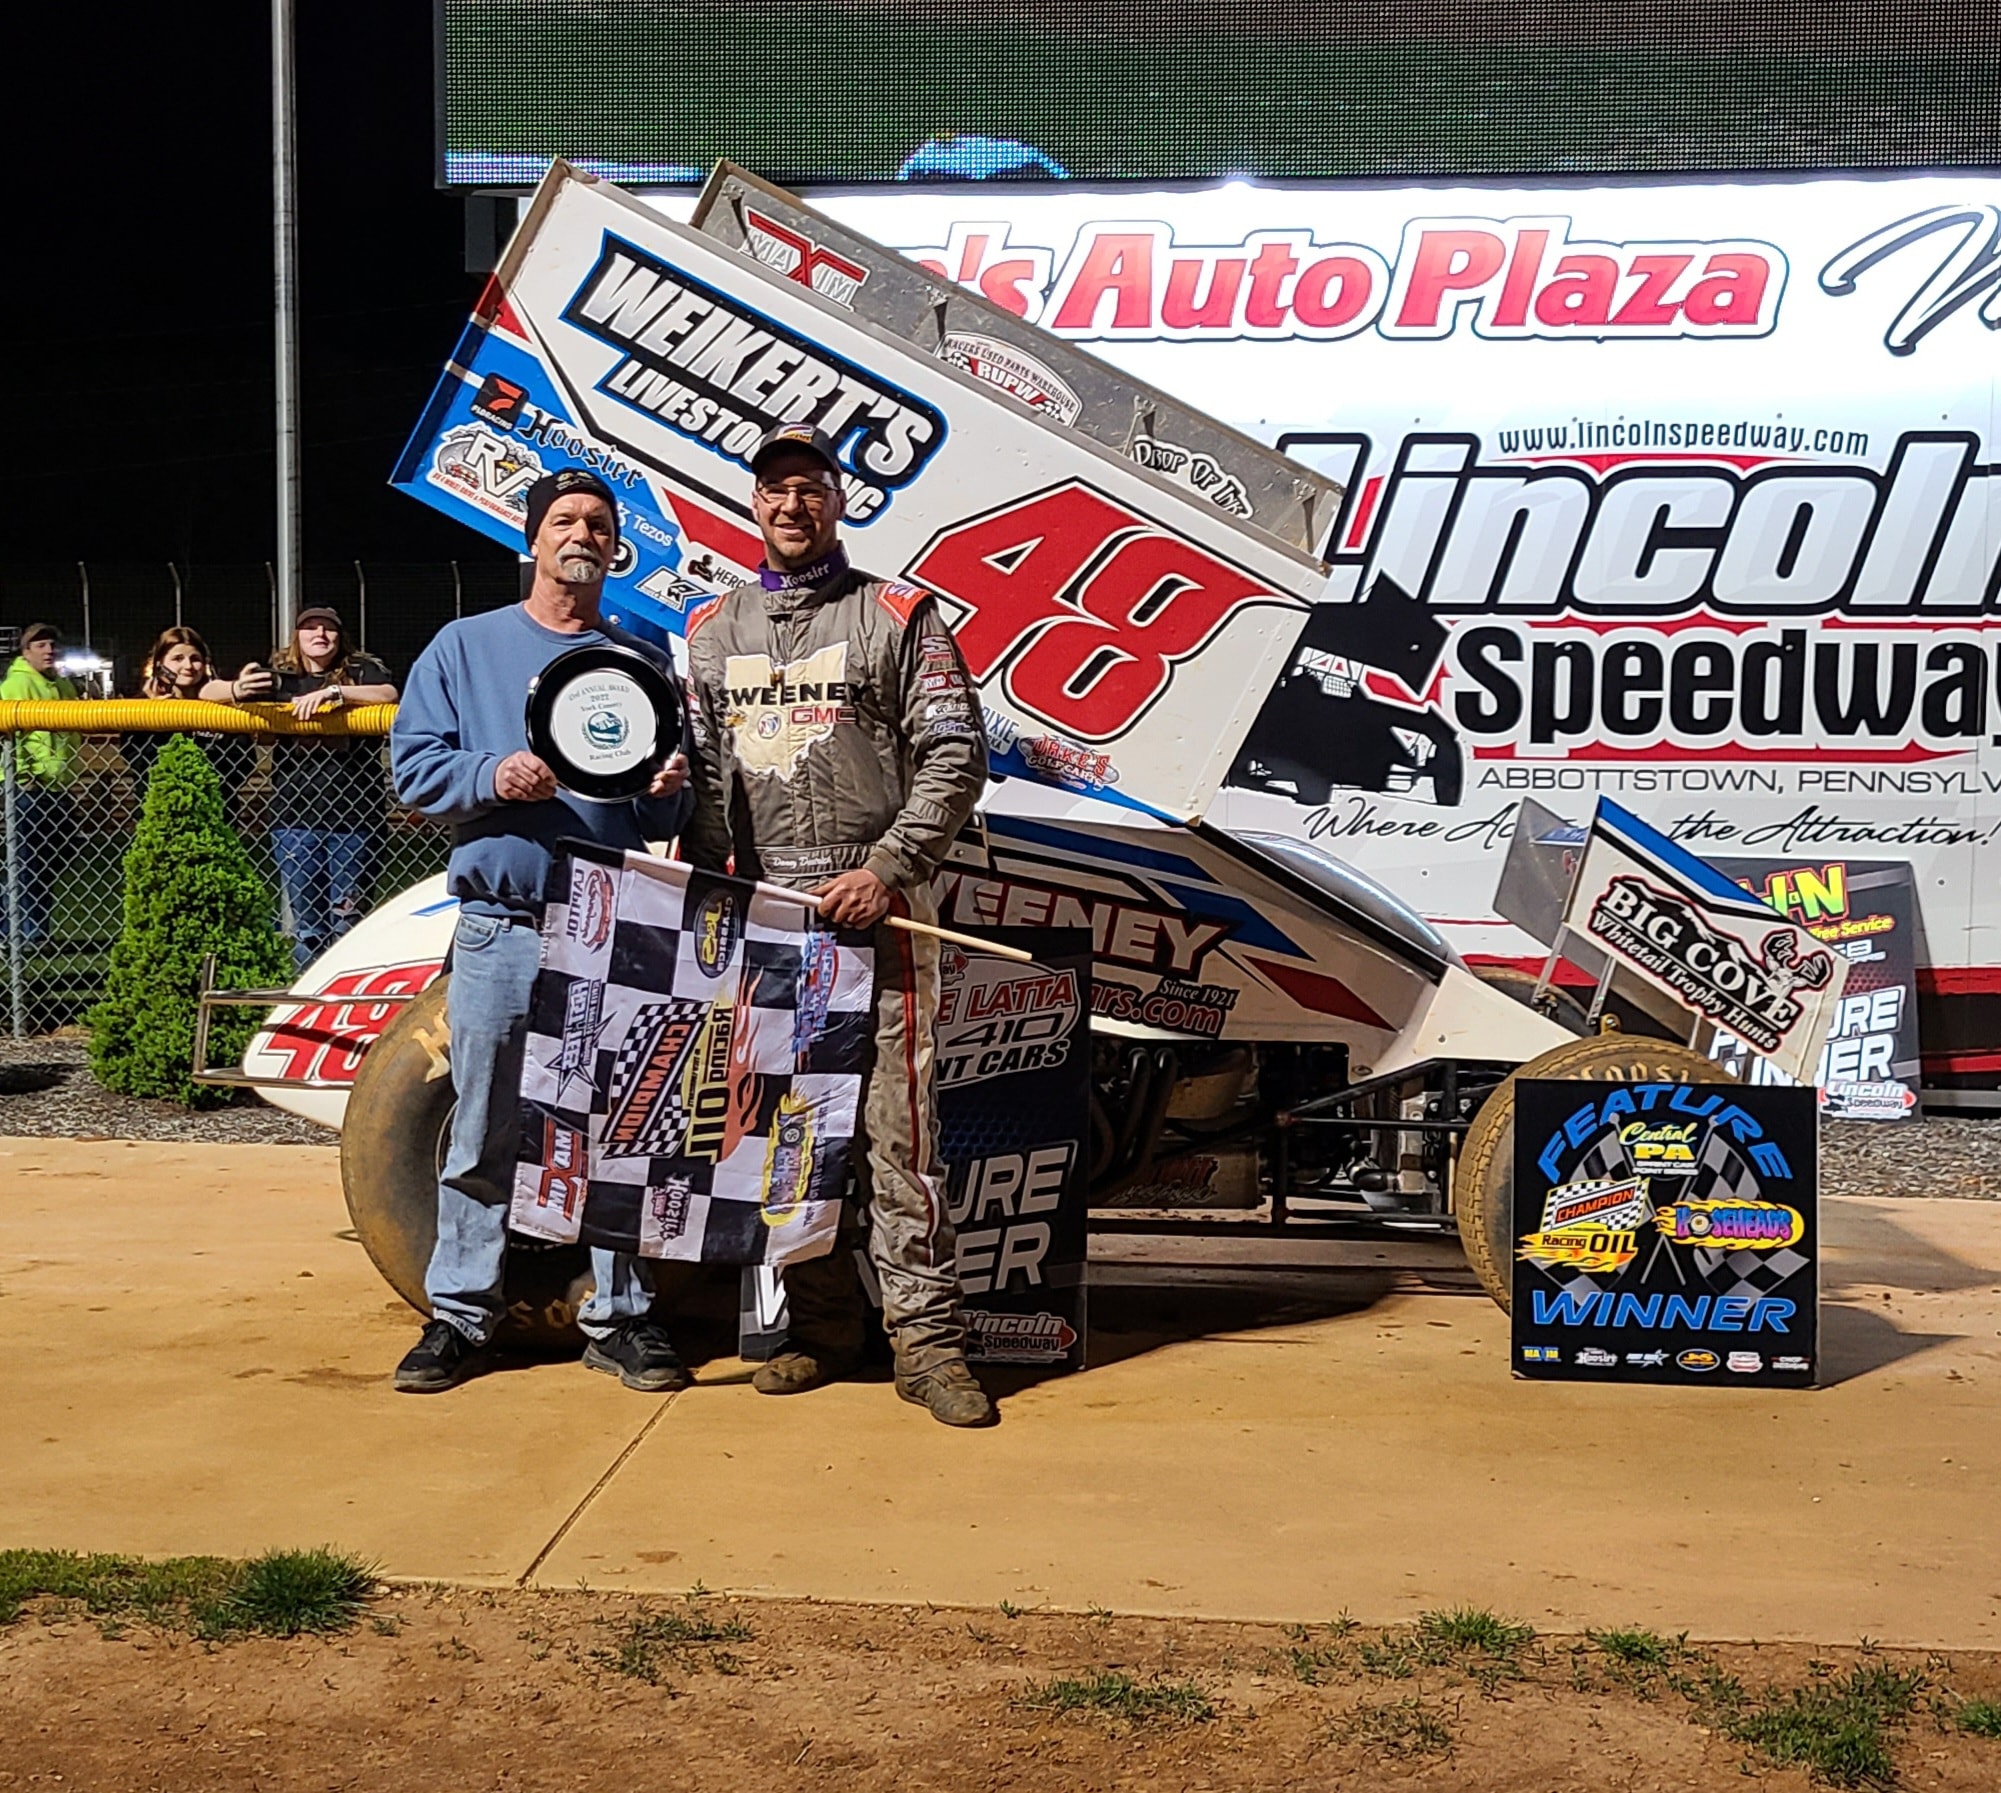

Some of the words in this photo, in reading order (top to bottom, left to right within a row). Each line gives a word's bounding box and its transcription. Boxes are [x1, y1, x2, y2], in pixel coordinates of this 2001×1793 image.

[1052, 233, 1369, 329] Auto
[1397, 230, 1767, 328] Plaza
[580, 252, 934, 476] WEIKERT'S
[977, 361, 1040, 402] RUPW
[980, 346, 1004, 364] USED
[1005, 357, 1030, 378] PARTS
[1031, 373, 1077, 412] WAREHOUSE
[517, 409, 644, 488] Hoosier
[607, 360, 764, 461] LIVESTO
[840, 473, 885, 520] NC
[1500, 421, 1868, 457] www.lincolnspeedway.com
[464, 430, 542, 496] RV
[1134, 440, 1188, 474] DROP
[1191, 459, 1223, 490] OF
[633, 514, 673, 547] Tezos
[780, 562, 831, 589] Hoosier
[908, 480, 1295, 742] 48
[722, 681, 871, 707] SWEENEY
[791, 707, 856, 723] GMC
[615, 749, 632, 757] Club
[1477, 771, 1784, 795] ABBOTTSTOWN,
[1303, 802, 1438, 840] Where
[1667, 806, 1741, 842] the
[1742, 805, 1999, 853] Attraction!
[1841, 917, 1893, 936] Service
[1601, 882, 1683, 950] BIG
[1685, 942, 1800, 1030] COVE
[969, 976, 1075, 1017] LATTA
[1159, 979, 1198, 1001] Since
[1201, 987, 1236, 1009] 1921
[1591, 910, 1669, 973] Whitetail
[1666, 966, 1727, 1015] Trophy
[1724, 1008, 1778, 1049] Hunts
[946, 1012, 1065, 1047] 410
[976, 1040, 1069, 1076] CARS
[1828, 1080, 1903, 1098] Lincoln
[1537, 1084, 1793, 1185] FEATURE
[1620, 1121, 1698, 1145] Central
[1634, 1143, 1695, 1160] PA
[1556, 1188, 1634, 1222] CHAMPION
[1542, 1232, 1587, 1249] Racing
[1590, 1233, 1638, 1254] OIL
[1532, 1290, 1796, 1333] WINNER
[984, 1335, 1060, 1352] Speedway
